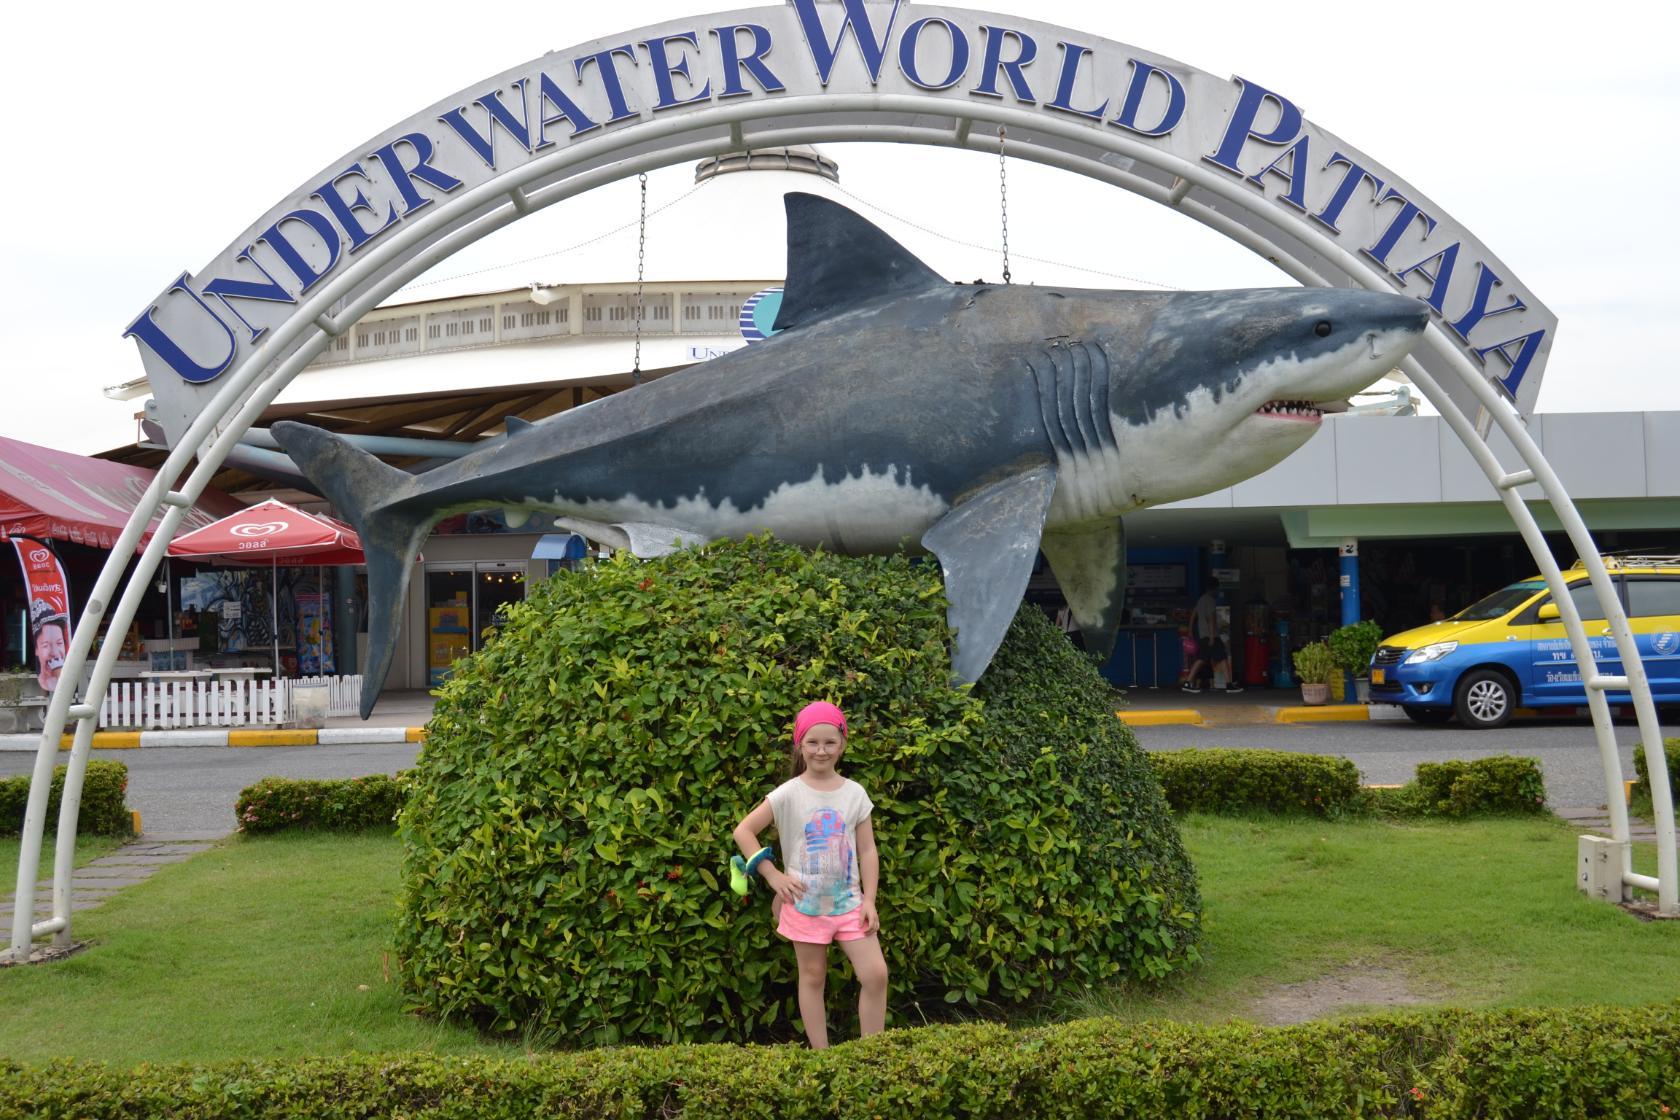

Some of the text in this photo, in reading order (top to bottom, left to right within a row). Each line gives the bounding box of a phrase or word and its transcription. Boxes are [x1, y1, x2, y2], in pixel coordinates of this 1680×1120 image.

[122, 0, 1545, 400] UNDERWATER WORLD PATTAYA
